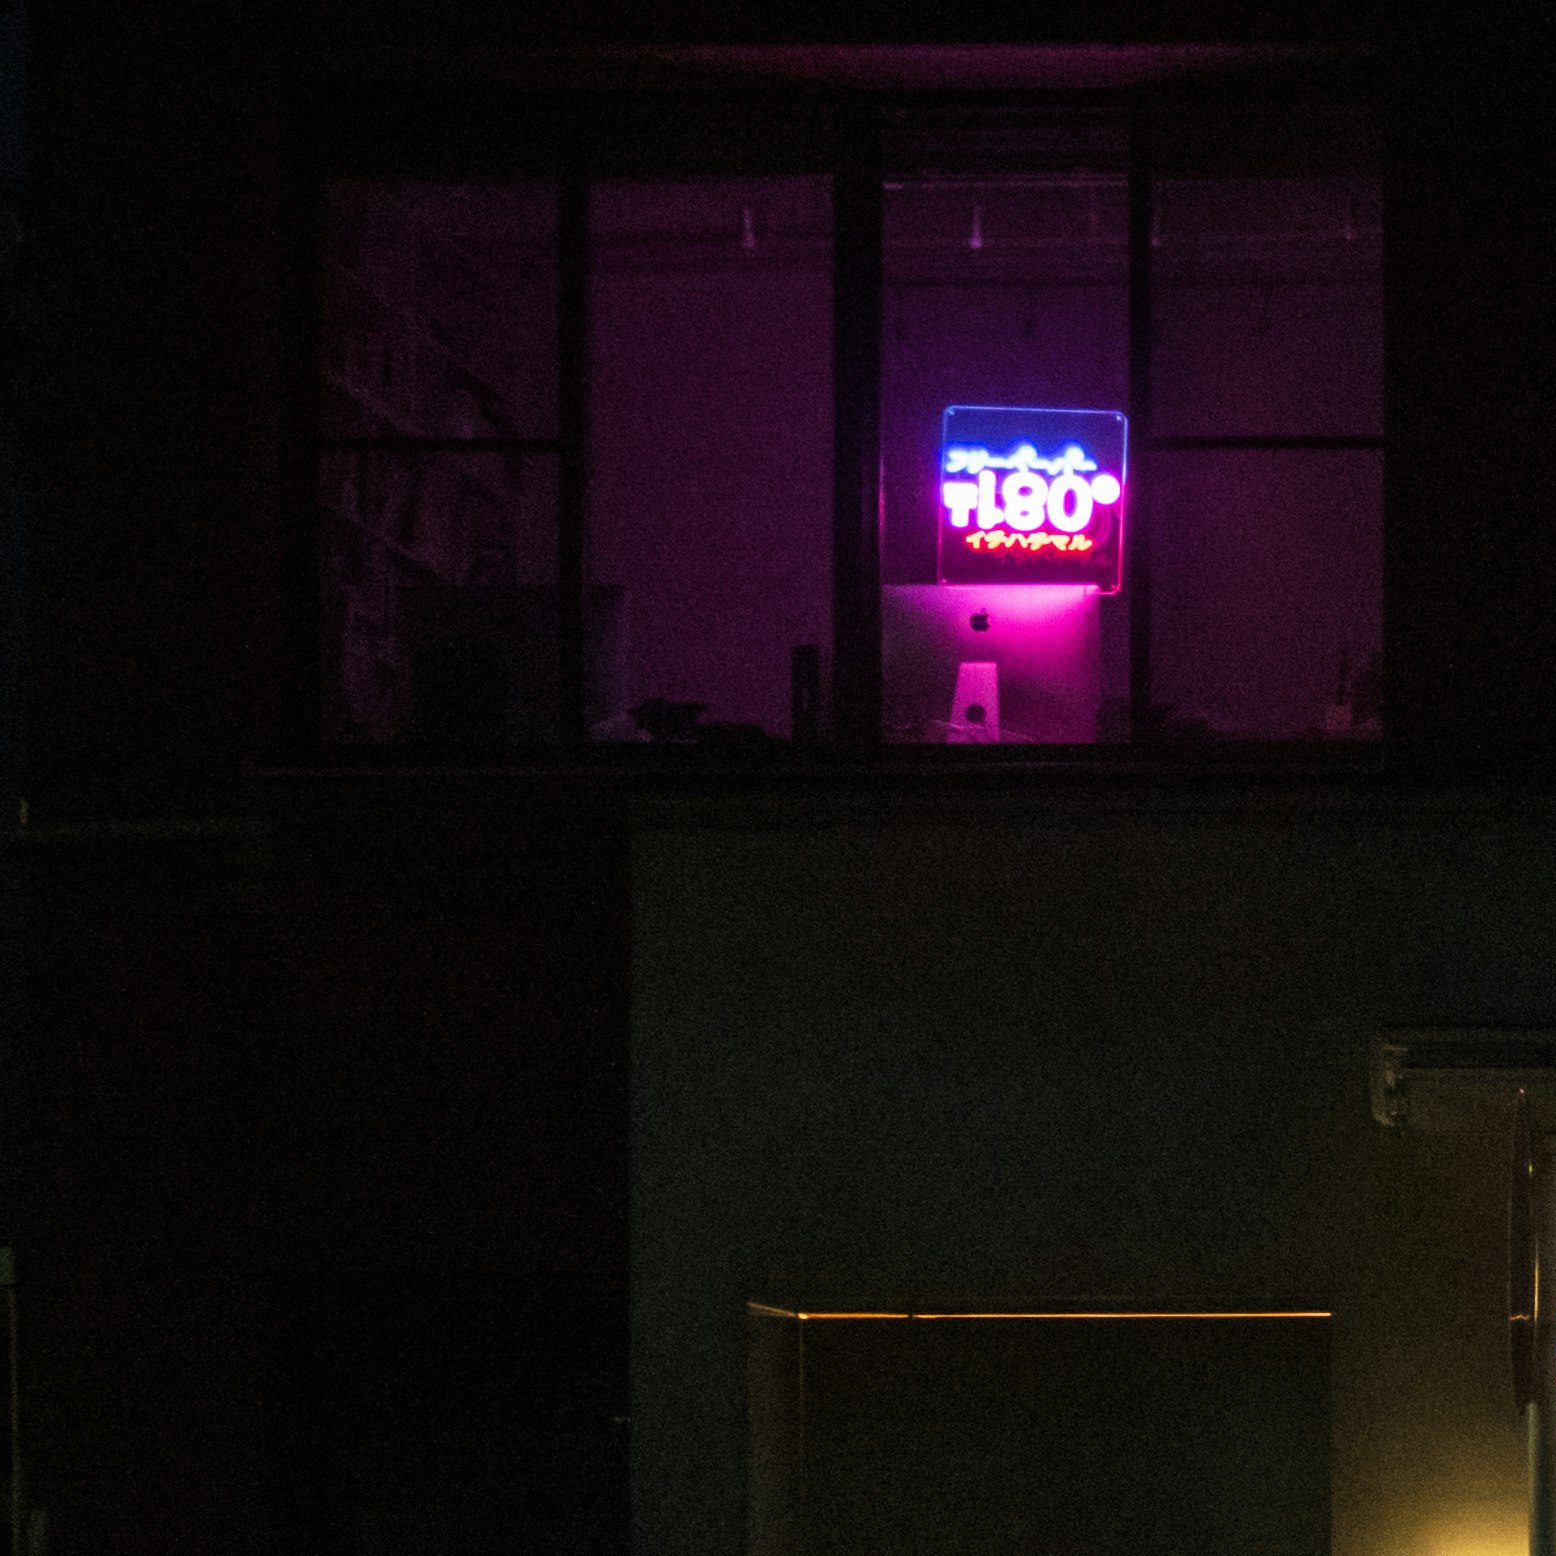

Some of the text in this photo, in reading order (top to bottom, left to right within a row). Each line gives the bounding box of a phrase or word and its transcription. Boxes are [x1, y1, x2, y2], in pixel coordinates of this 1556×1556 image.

[965, 529, 1094, 551] イチハチマル
